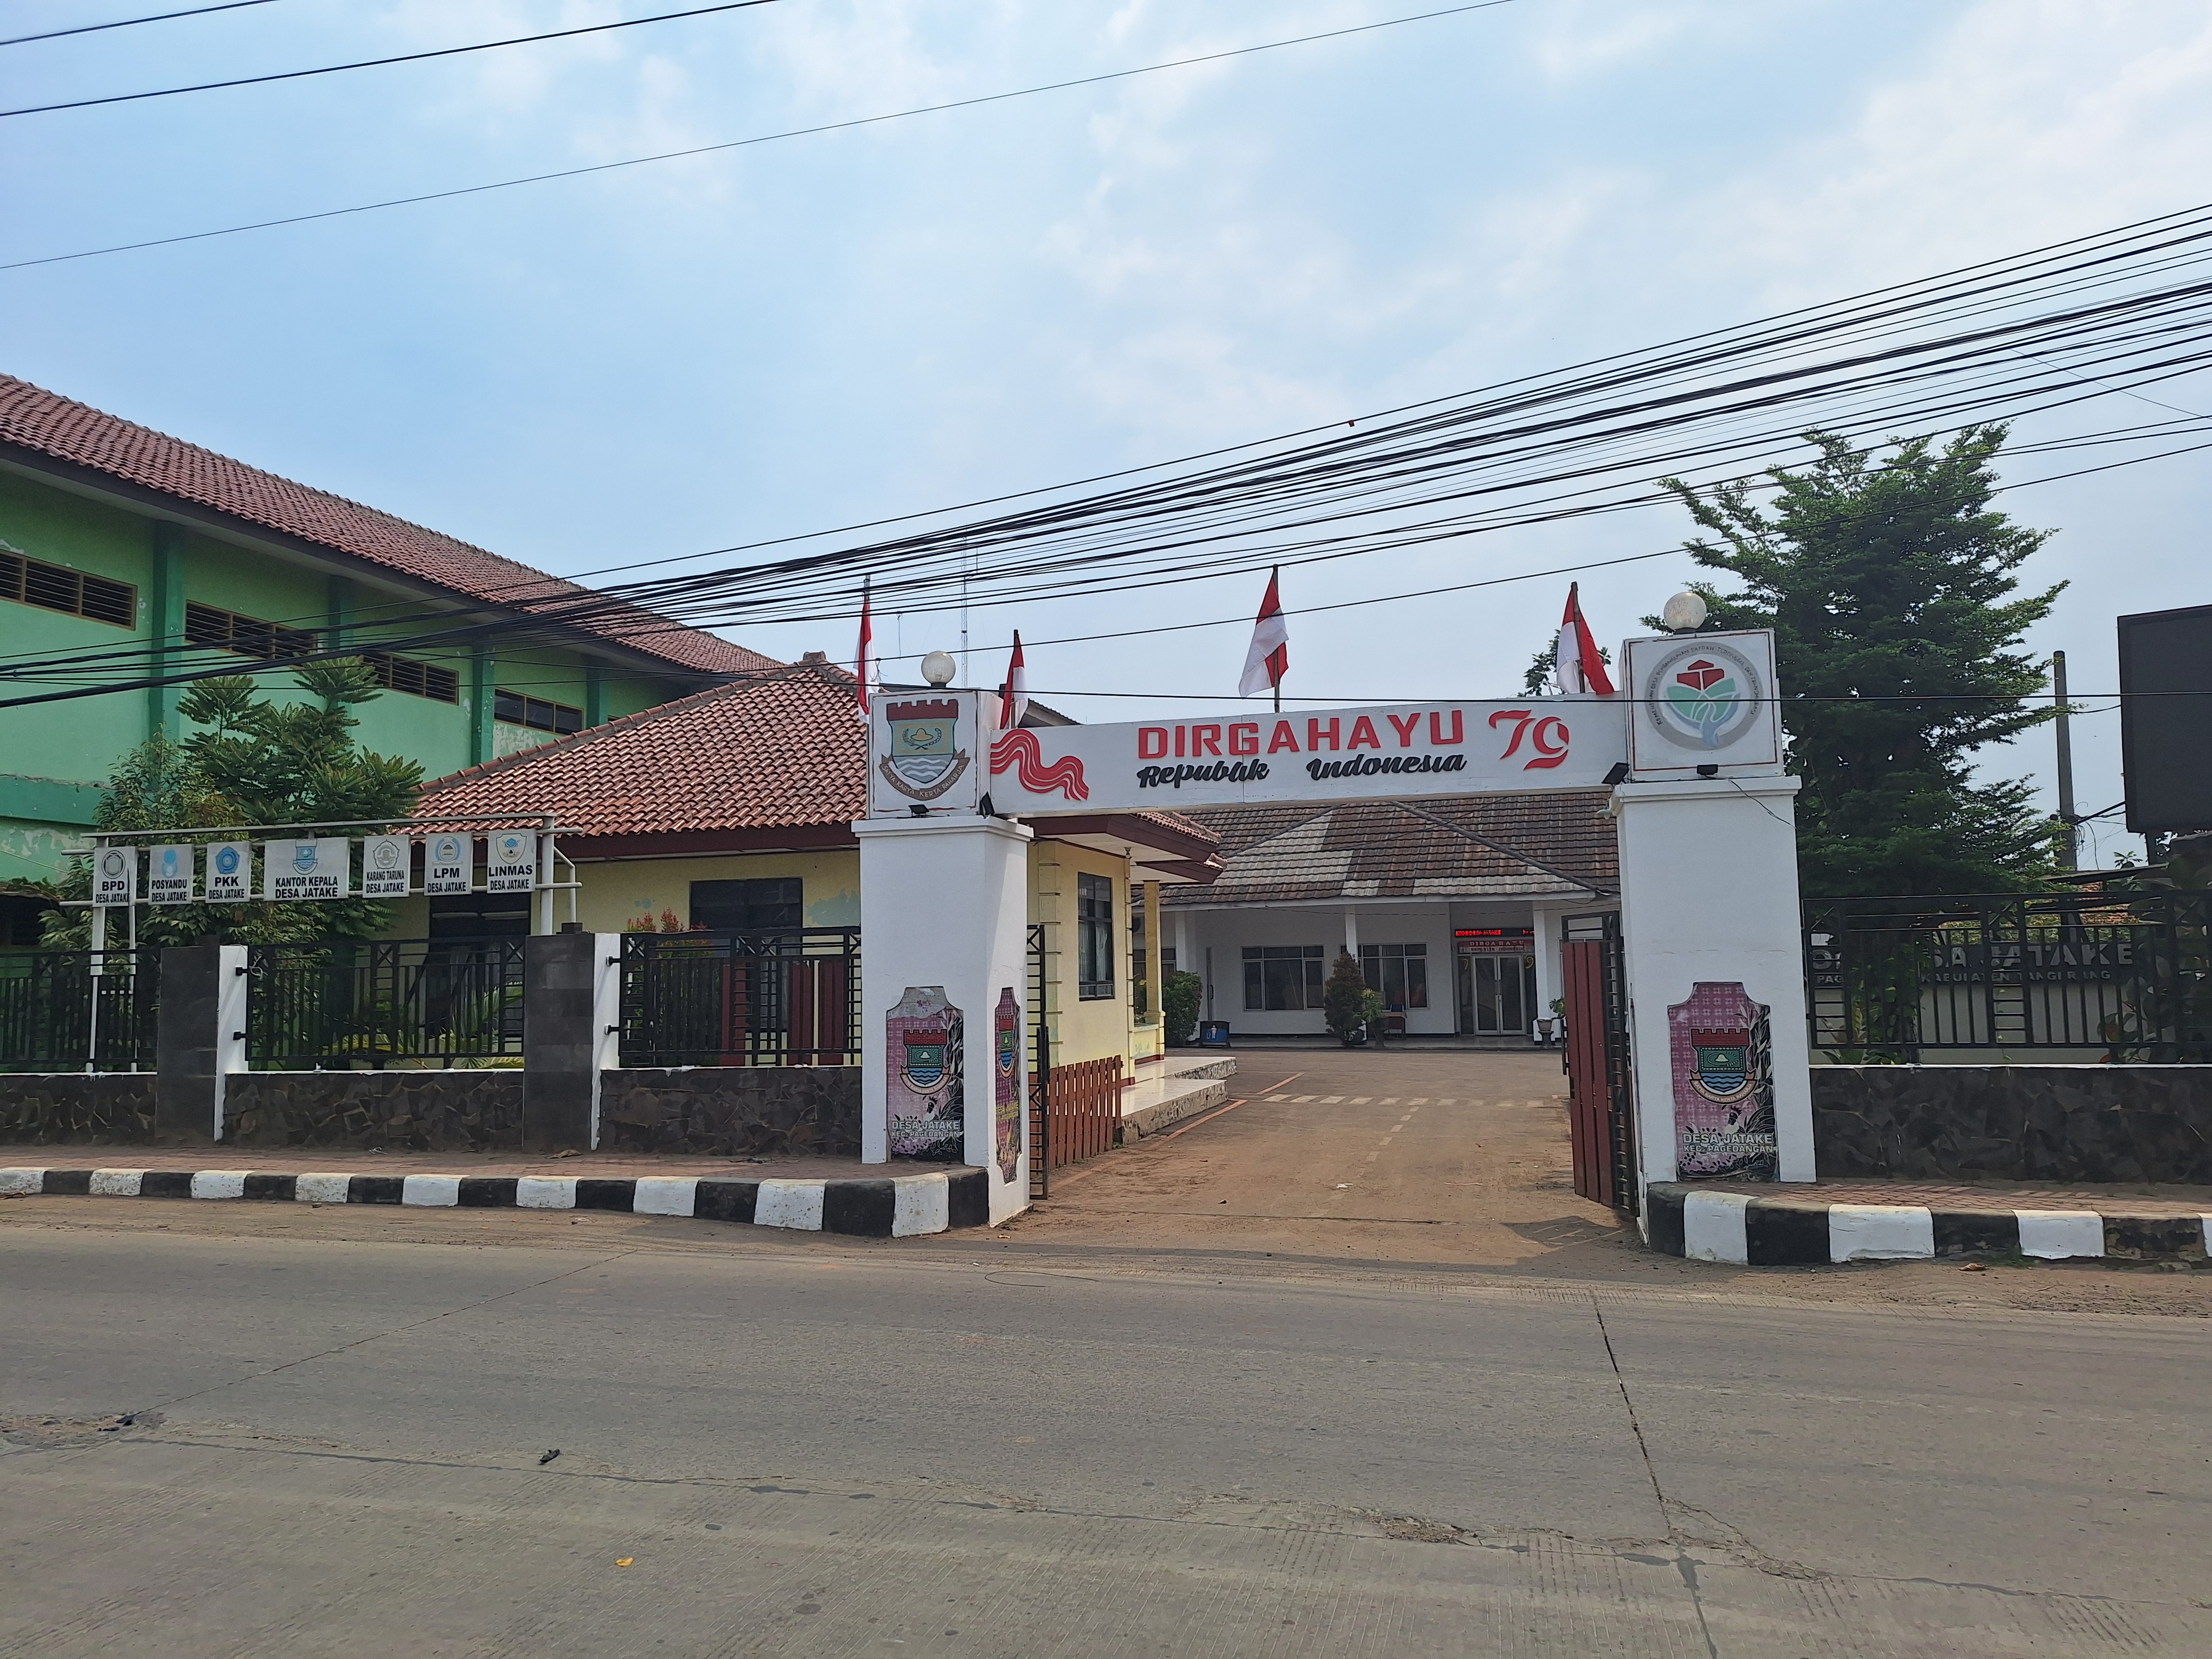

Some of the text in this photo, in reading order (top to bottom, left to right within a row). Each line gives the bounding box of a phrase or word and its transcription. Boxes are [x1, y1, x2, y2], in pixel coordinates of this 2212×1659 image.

[1138, 709, 1463, 759] DIRGAHAYU
[1488, 709, 1570, 771] 79
[882, 764, 964, 798] SATYA KARYA KERTA RAHARJA
[366, 870, 404, 882] KARANG TARUNA
[434, 867, 460, 878] LPM
[488, 865, 533, 877] LINMAS
[102, 880, 125, 891] BPD
[151, 879, 188, 889] POSYANDU
[215, 876, 240, 887] PKK
[275, 876, 338, 887] KANTOR KEPALA
[490, 879, 529, 890] DESA JATAKE
[275, 887, 338, 898] DESA JATAKE
[366, 882, 404, 893] DESA JATAKE
[427, 882, 466, 893] DESA JATAKE
[96, 892, 130, 903] DESA JATAKE
[152, 891, 187, 902] DESA JATAKE
[209, 889, 245, 899] DESA JATAKE
[2018, 970, 2111, 981] TANGRNG
[892, 1121, 960, 1129] DESA JATAKE
[1683, 1134, 1773, 1144] DESA JATAKE
[1708, 1145, 1773, 1153] PAGEDANGAN
